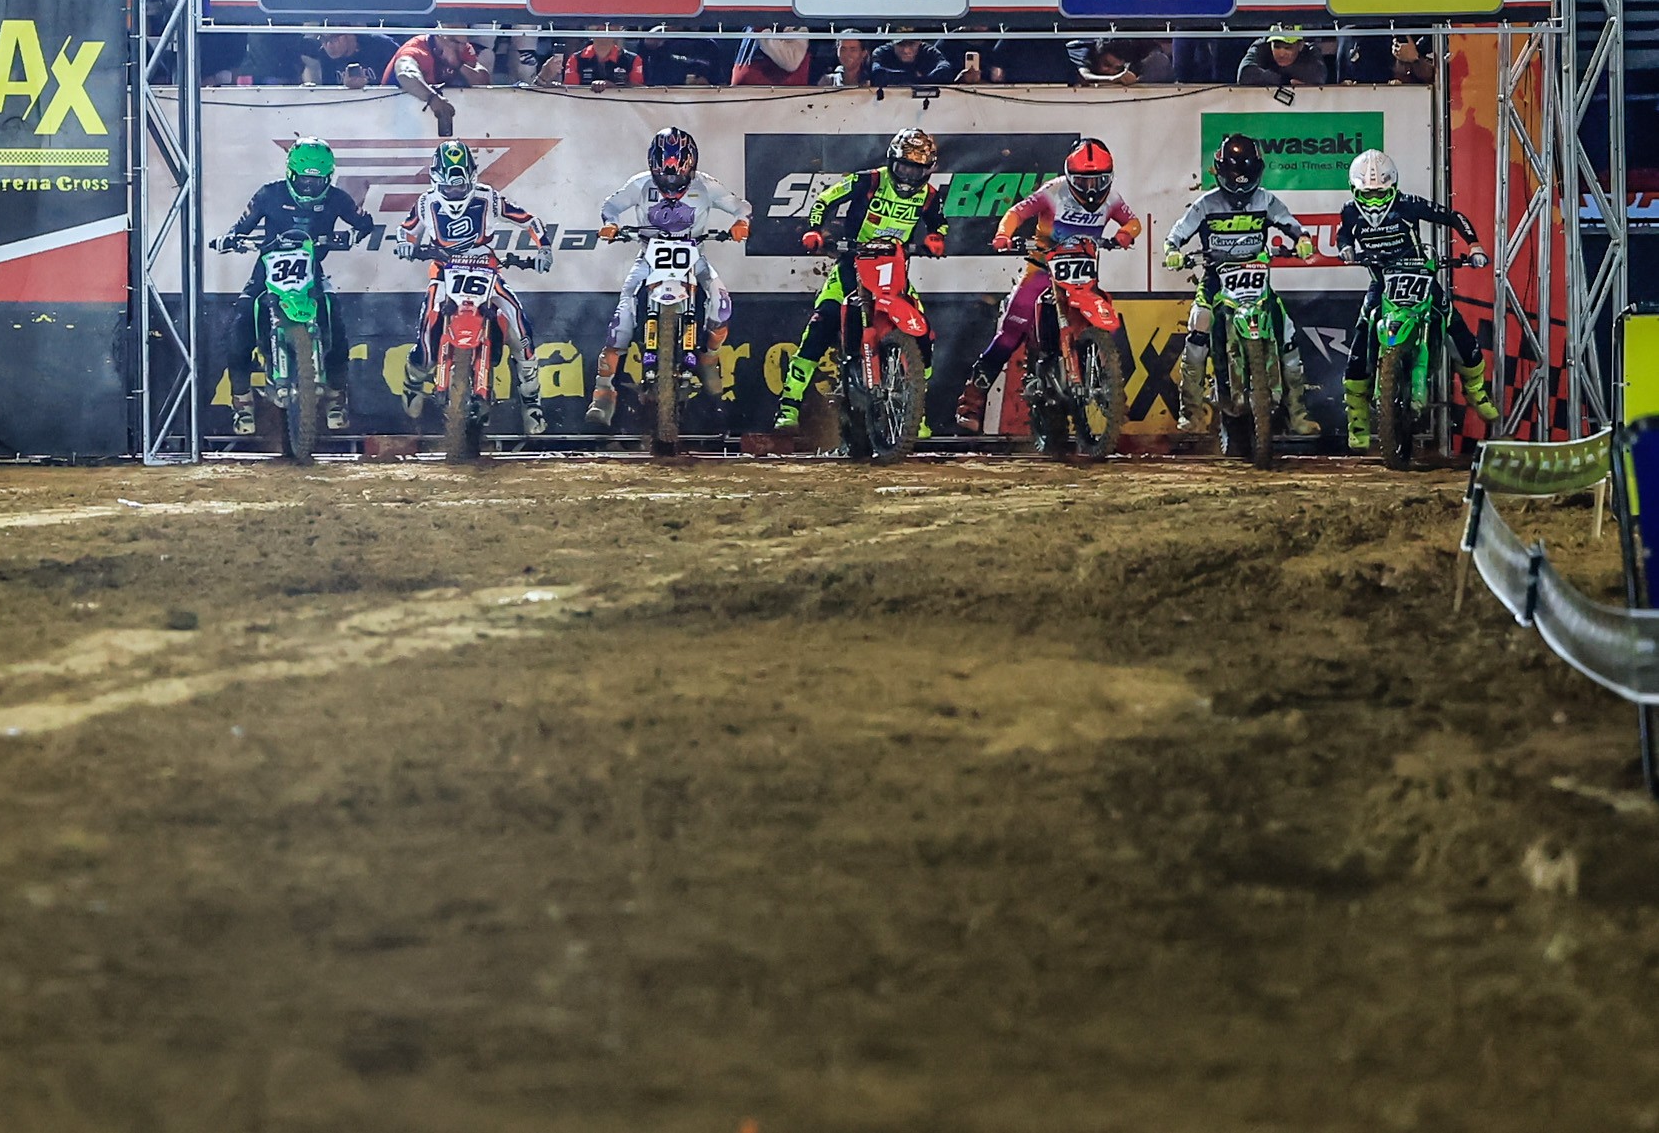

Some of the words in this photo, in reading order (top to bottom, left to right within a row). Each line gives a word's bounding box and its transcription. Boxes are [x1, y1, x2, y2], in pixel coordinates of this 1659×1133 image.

[1302, 161, 1333, 170] Times
[1335, 161, 1350, 170] Ro
[55, 175, 109, 192] Cross
[1061, 210, 1104, 225] LEATT
[654, 247, 690, 270] 20
[271, 259, 308, 282] 34
[875, 262, 894, 287] 1
[1054, 260, 1097, 281] 874
[451, 274, 490, 295] 16
[1225, 271, 1265, 292] 848
[1386, 274, 1430, 302] 134
[863, 343, 874, 390] DUNLOP
